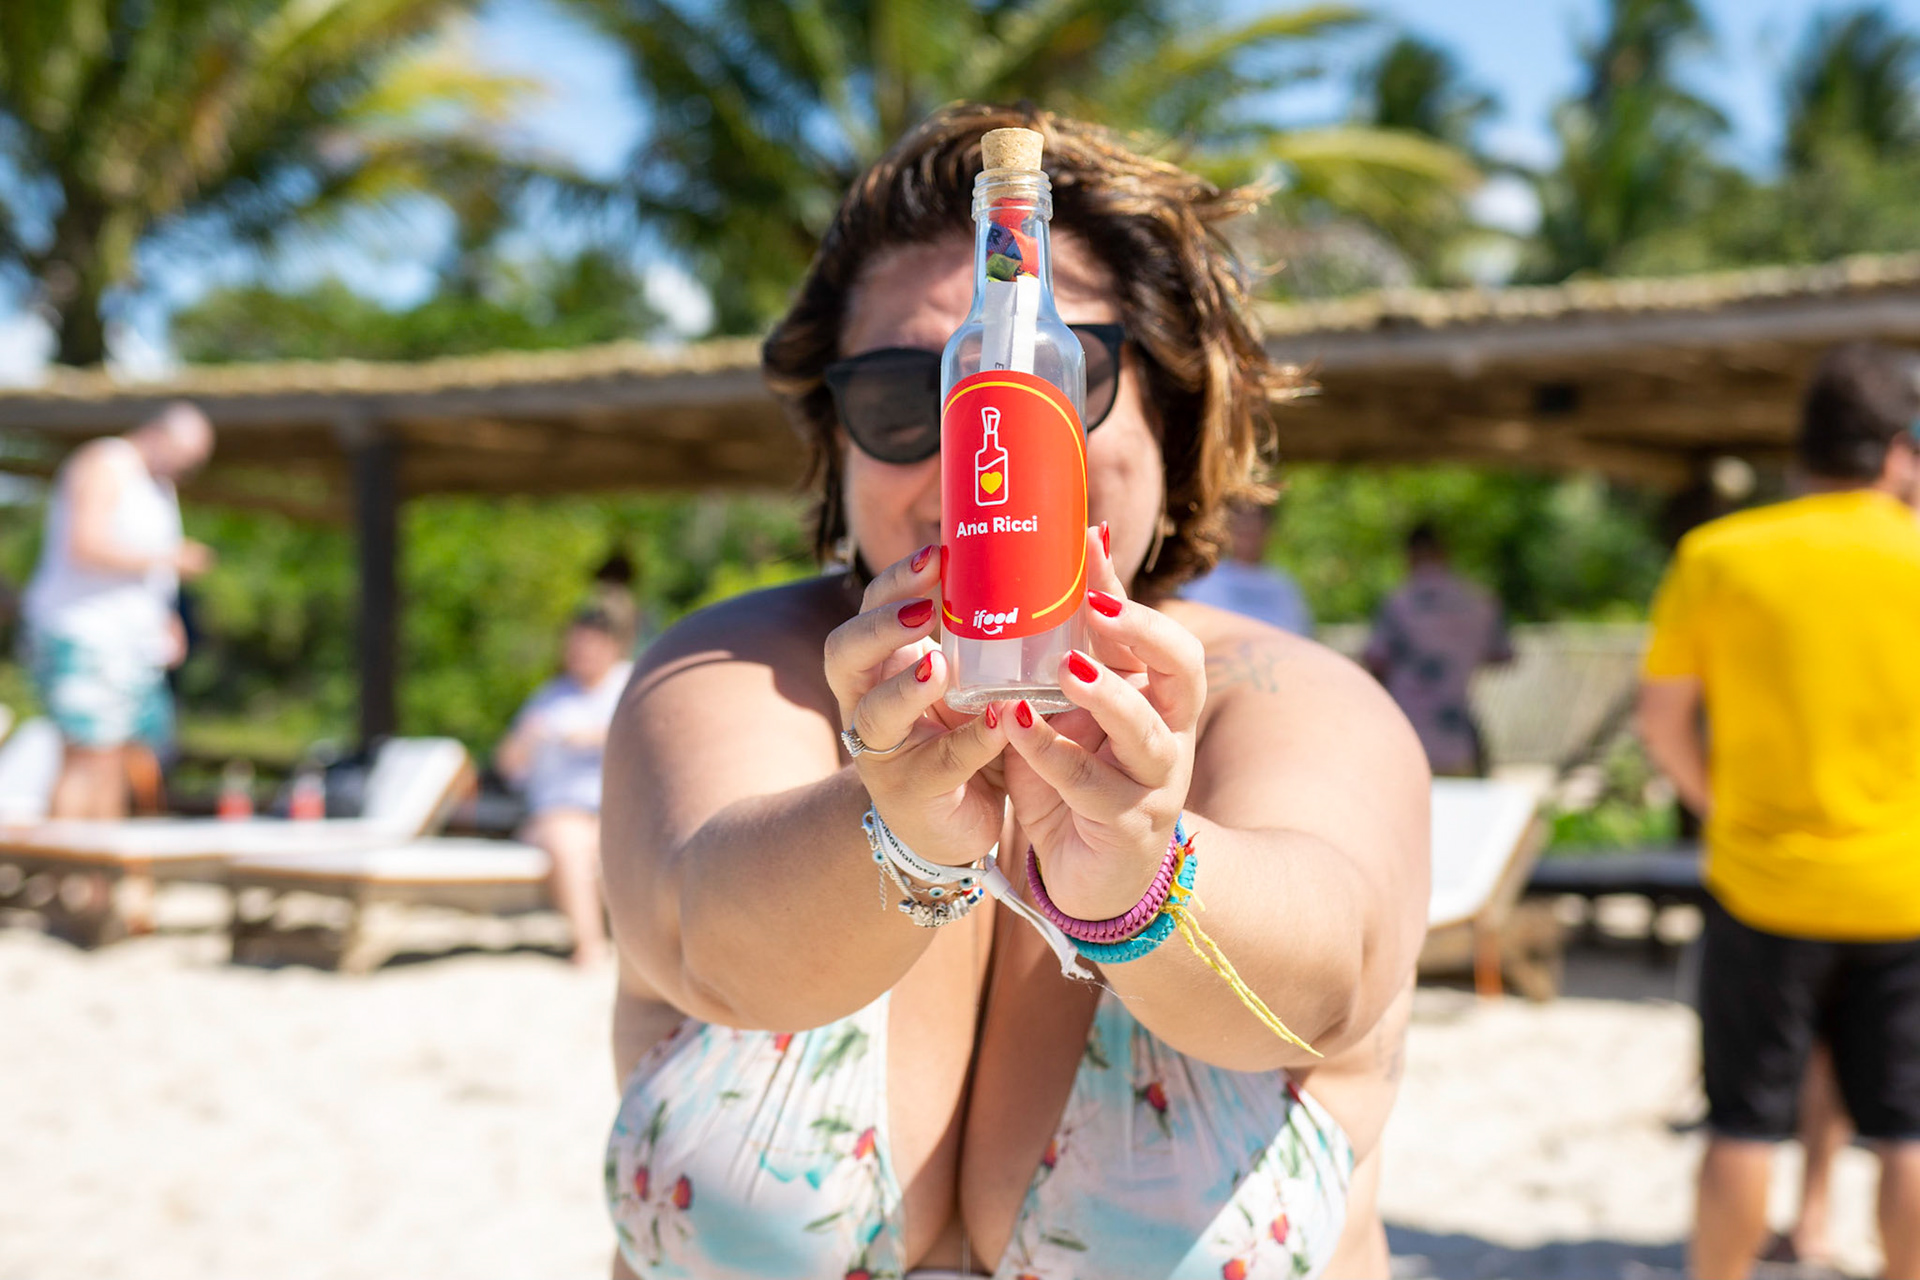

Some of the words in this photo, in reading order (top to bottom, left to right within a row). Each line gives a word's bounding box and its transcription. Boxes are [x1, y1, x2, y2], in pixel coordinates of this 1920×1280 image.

[956, 522, 988, 538] Ana
[993, 515, 1037, 533] Ricci
[973, 608, 1019, 628] ifood
